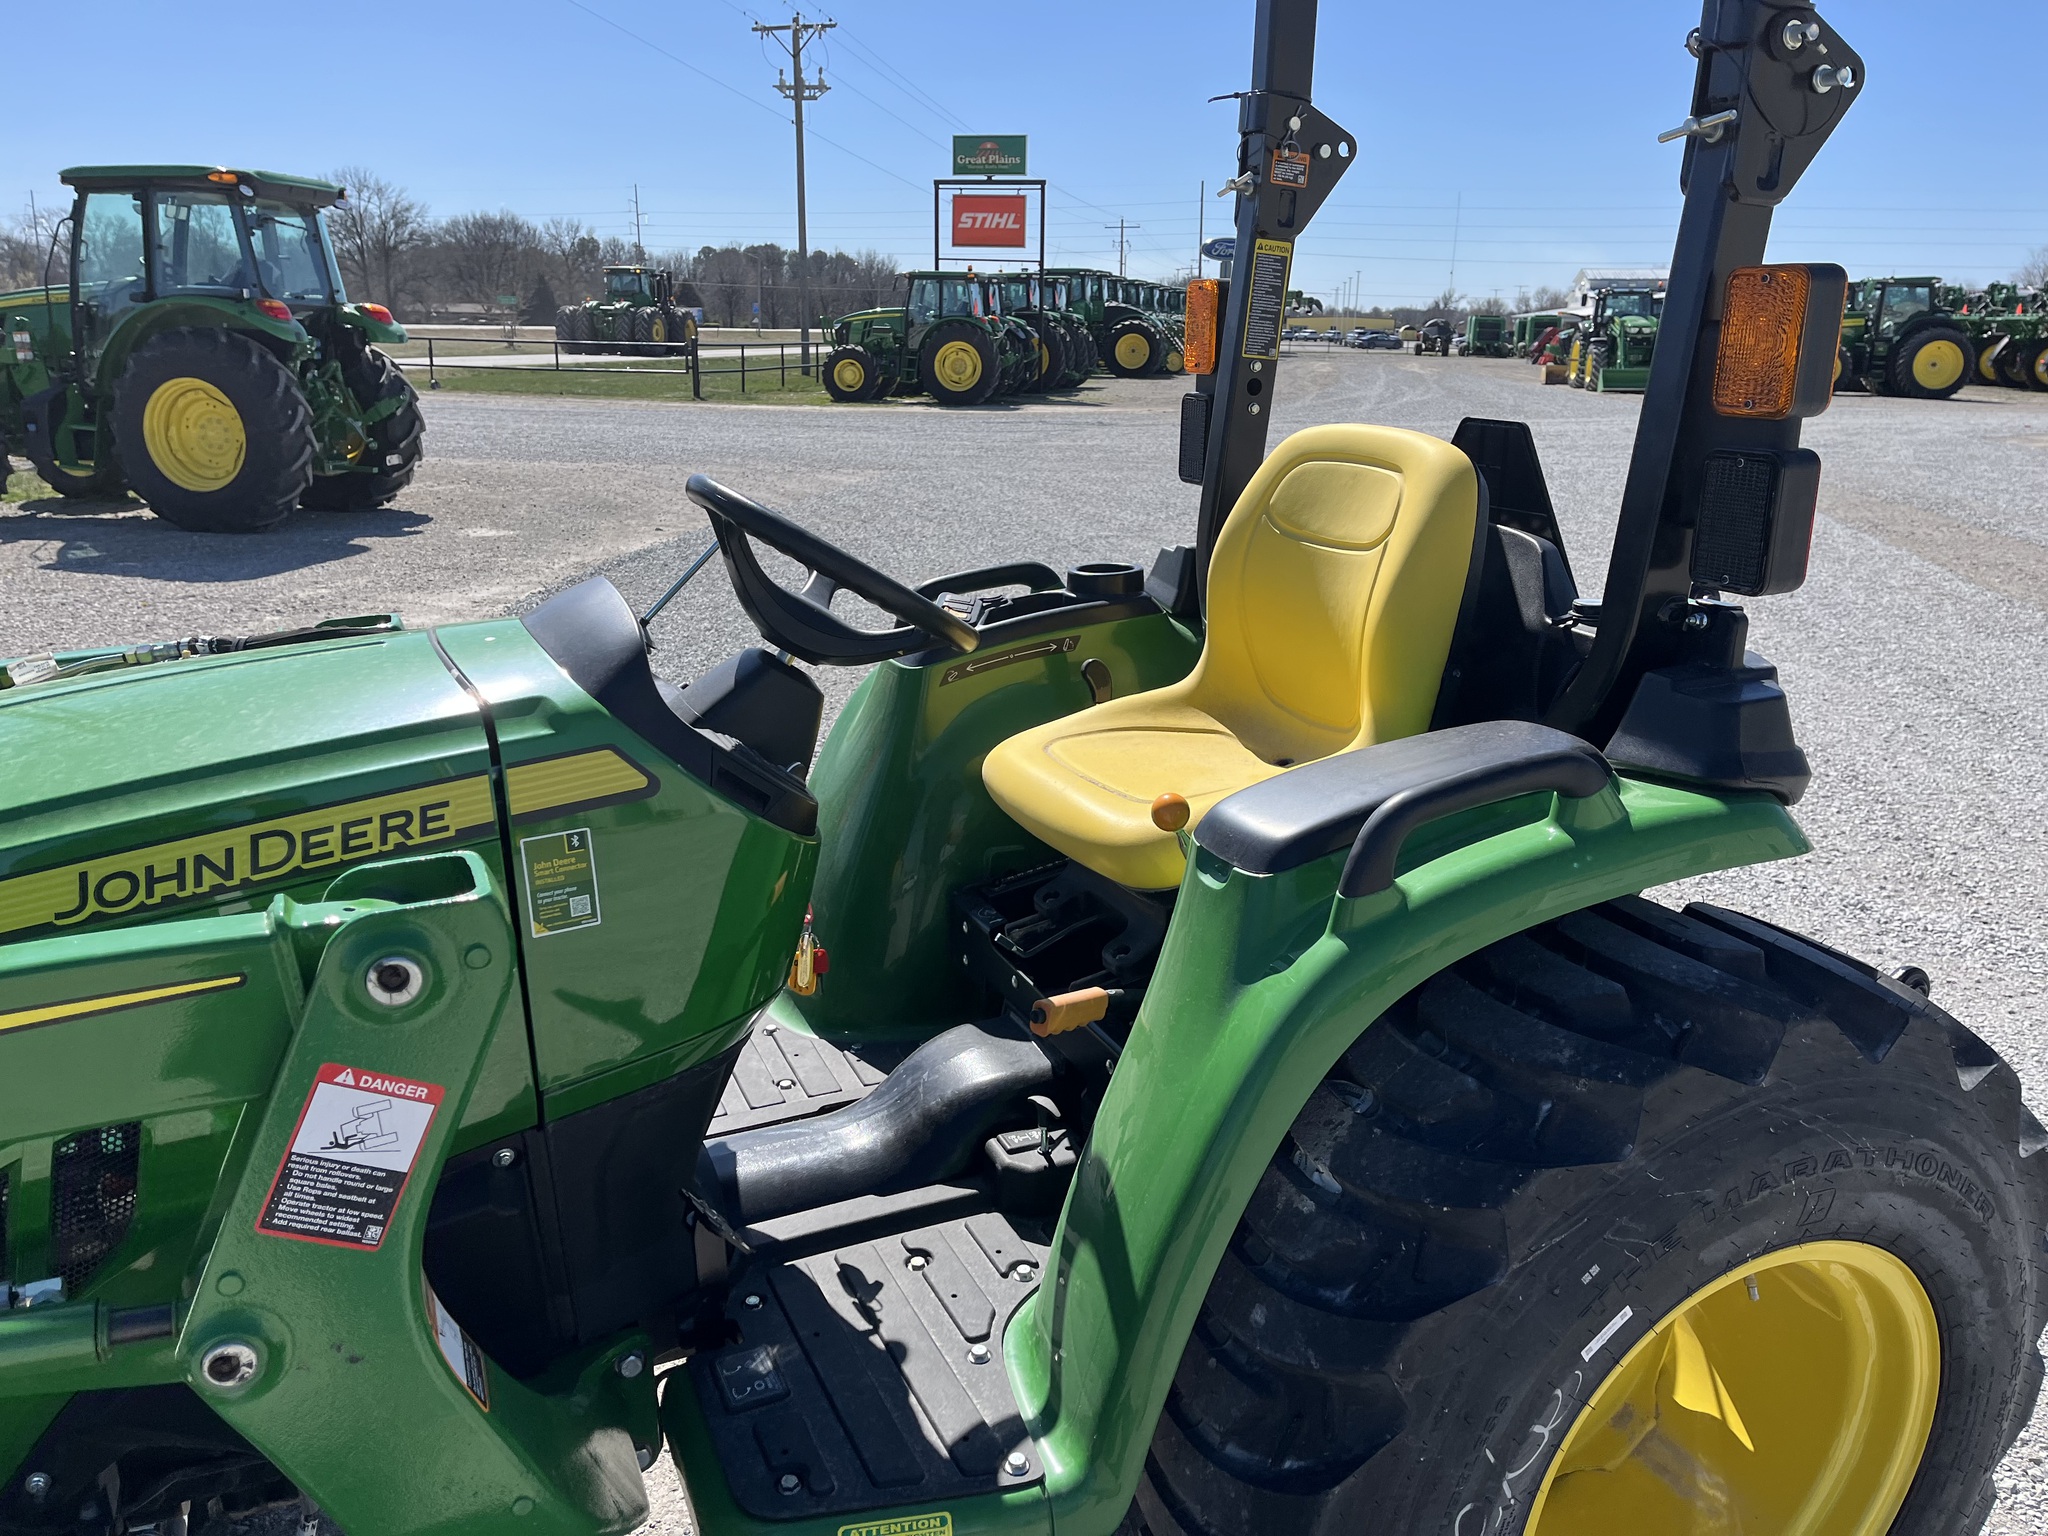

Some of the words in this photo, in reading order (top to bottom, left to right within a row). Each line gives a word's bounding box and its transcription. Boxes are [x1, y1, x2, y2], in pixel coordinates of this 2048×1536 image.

[957, 154, 986, 164] Great
[988, 154, 1021, 164] Plains
[957, 212, 1021, 229] STIHL
[1211, 241, 1234, 256] For
[1264, 244, 1290, 254] CAUTION
[53, 847, 235, 921] JOHN
[249, 800, 451, 876] DEERE
[533, 861, 552, 870] John
[553, 857, 576, 866] Deere
[533, 868, 554, 877] Smart
[555, 863, 588, 872] Connector
[359, 1075, 428, 1099] DANGER
[288, 1162, 309, 1170] result
[310, 1166, 327, 1174] from
[329, 1170, 361, 1180] rollovers.
[290, 1154, 318, 1165] Serious
[320, 1160, 340, 1170] injury
[351, 1166, 372, 1175] death
[289, 1178, 314, 1186] square
[316, 1181, 337, 1190] bales.
[318, 1175, 342, 1184] handle
[344, 1180, 365, 1188] round
[375, 1185, 393, 1193] large
[1697, 1146, 1996, 1226] MARATHONER
[294, 1193, 316, 1201] times.
[303, 1187, 322, 1195] Rops
[338, 1193, 367, 1203] seatbelt
[278, 1204, 298, 1213] Move
[300, 1208, 325, 1217] wheels
[336, 1214, 360, 1223] widest
[281, 1197, 310, 1208] Operate
[312, 1203, 337, 1211] tractor
[361, 1212, 384, 1220] speed.
[272, 1218, 287, 1226] Add
[288, 1221, 320, 1231] required
[336, 1227, 362, 1238] ballast.
[275, 1212, 328, 1225] recommended
[329, 1220, 355, 1230] setting.
[851, 1518, 941, 1536] ATTENTION
